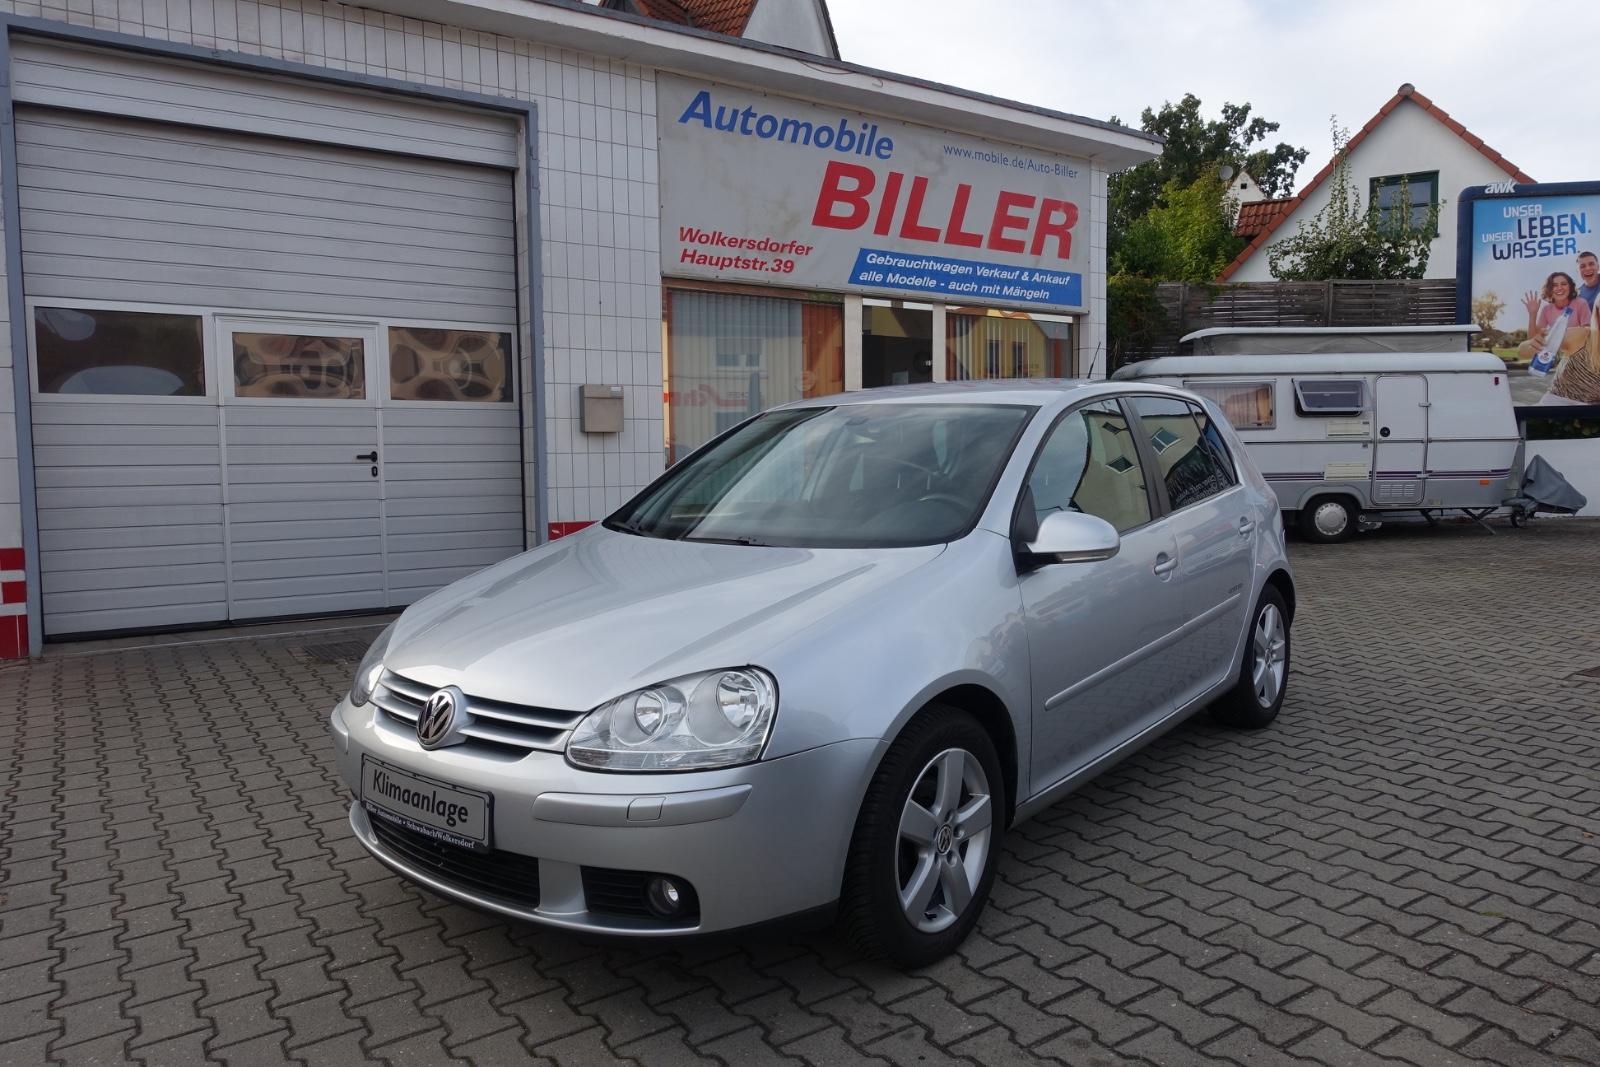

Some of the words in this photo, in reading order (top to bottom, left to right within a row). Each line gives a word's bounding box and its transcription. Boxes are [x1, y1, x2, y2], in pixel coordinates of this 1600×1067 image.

[678, 91, 894, 160] Automobile
[943, 144, 1079, 180] www.mobile.de/Auto-Biller
[1484, 180, 1517, 194] awk
[811, 160, 1079, 259] BILLER
[1503, 204, 1543, 218] UNSER
[679, 226, 814, 257] Wolkersdorfer
[1481, 232, 1514, 243] UNSER
[1517, 213, 1592, 240] LEBEN.
[680, 248, 795, 274] Hauptstr.39
[1492, 237, 1581, 261] WASSER.
[866, 253, 973, 275] Gebrauchtwagen
[976, 266, 1020, 280] Verkauf
[1022, 272, 1029, 281] &
[1032, 272, 1070, 286] Ankauf
[859, 270, 884, 282] alle
[886, 273, 937, 288] Modelle
[948, 280, 978, 293] auch
[980, 285, 1001, 295] mit
[1002, 285, 1050, 300] Mängeln
[373, 768, 469, 828] Klimaanlage
